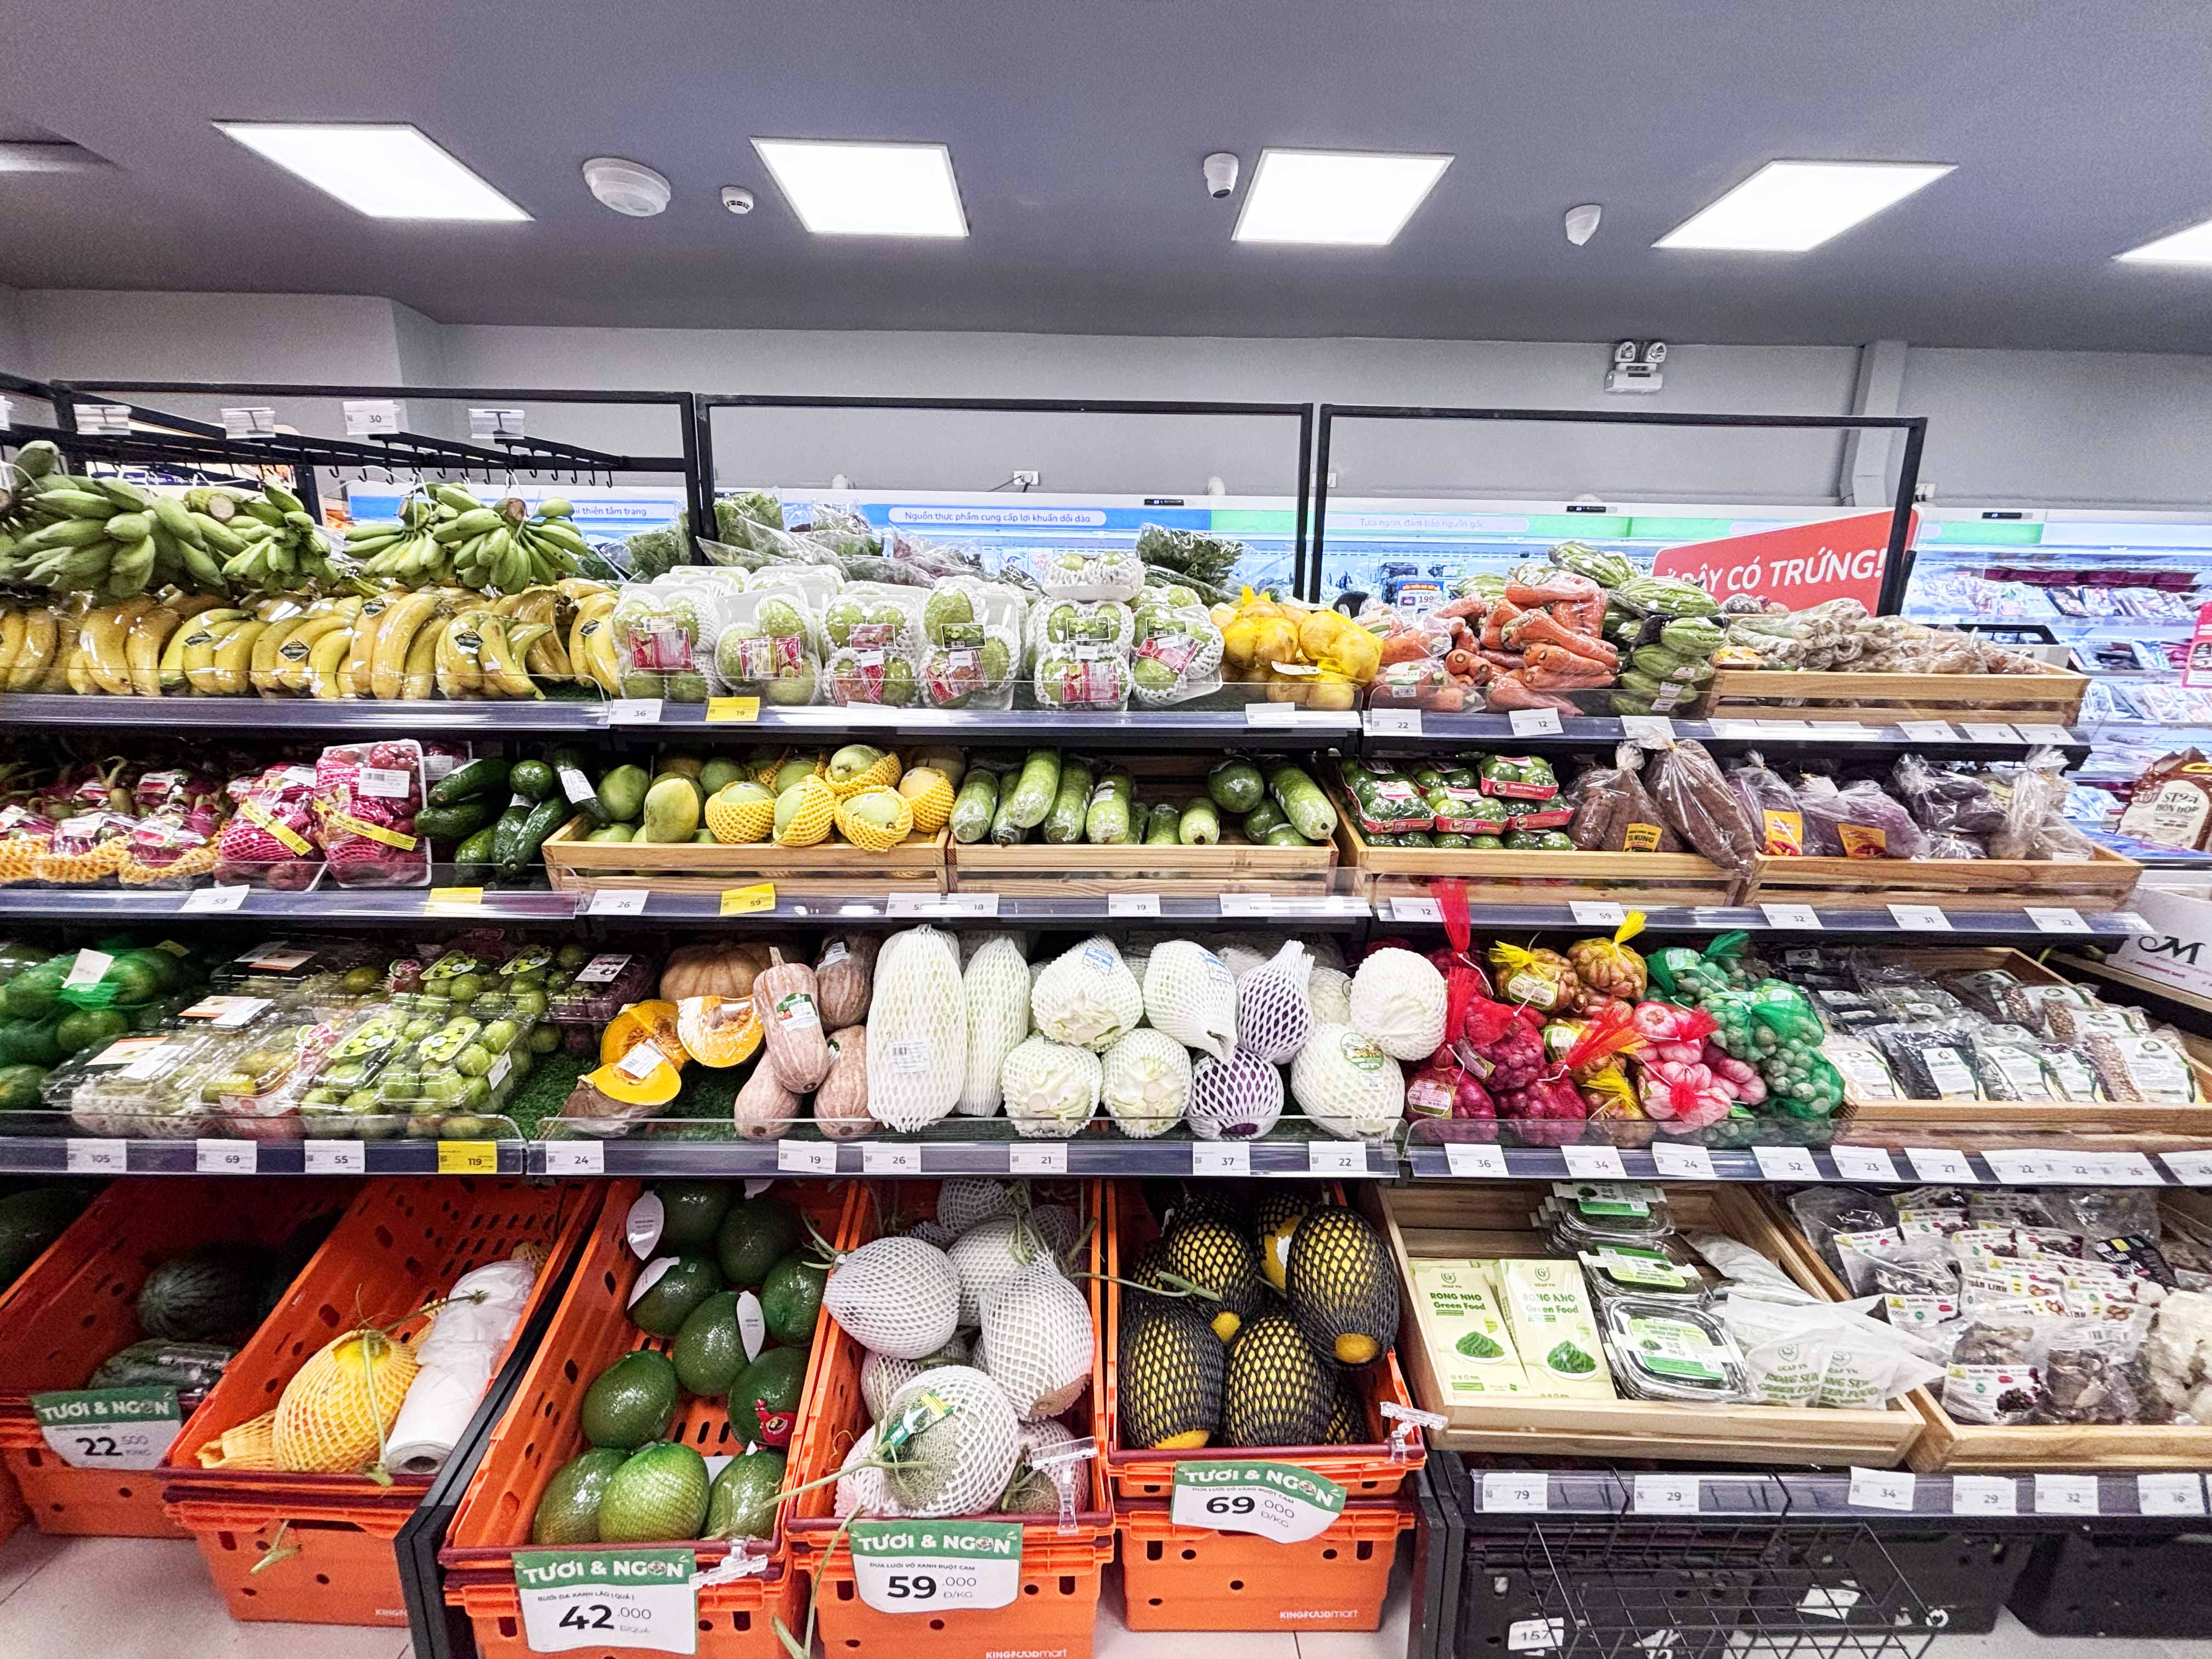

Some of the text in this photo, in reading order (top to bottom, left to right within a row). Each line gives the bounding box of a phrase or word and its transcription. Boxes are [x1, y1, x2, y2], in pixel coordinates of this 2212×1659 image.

[369, 414, 381, 422] 30
[1726, 556, 1761, 590] CÓ
[1769, 546, 1888, 587] TRỨNG!
[92, 1155, 110, 1163] 105
[225, 1155, 240, 1164] 69
[334, 1155, 349, 1164] 55
[467, 1158, 482, 1166] 119
[574, 1156, 589, 1164] 24
[809, 1155, 821, 1164] 19
[892, 1156, 906, 1164] 26
[1040, 1156, 1052, 1164] 21
[1221, 1157, 1235, 1166] 37
[1339, 1158, 1352, 1166] 22
[1477, 1159, 1491, 1168] 36
[1594, 1160, 1609, 1169] 34
[1684, 1159, 1698, 1169] 24
[1788, 1162, 1804, 1171] 52
[1866, 1163, 1880, 1171] 23
[1942, 1164, 1955, 1173] 27
[2018, 1165, 2035, 1173] 22
[1430, 1292, 1482, 1301] RONG NHO
[1464, 1302, 1486, 1311] Food
[1556, 1305, 1579, 1314] Food
[40, 1401, 91, 1421] TƯƠI
[94, 1401, 108, 1415] &
[75, 1436, 123, 1456] 22
[1184, 1468, 1239, 1482] TƯƠI
[1244, 1470, 1260, 1480] &
[1514, 1489, 1530, 1499] 79
[1666, 1491, 1681, 1502] 29
[1880, 1488, 1897, 1499] 34
[2066, 1493, 2080, 1503] 32
[1278, 1493, 1294, 1504] CAM
[1983, 1493, 1999, 1504] 29
[1206, 1496, 1255, 1514] 69
[857, 1534, 914, 1551] TƯƠI
[921, 1534, 936, 1548] &
[523, 1560, 584, 1584] TƯƠI
[590, 1561, 606, 1575] &
[887, 1575, 936, 1599] 59
[558, 1604, 614, 1629] 42
